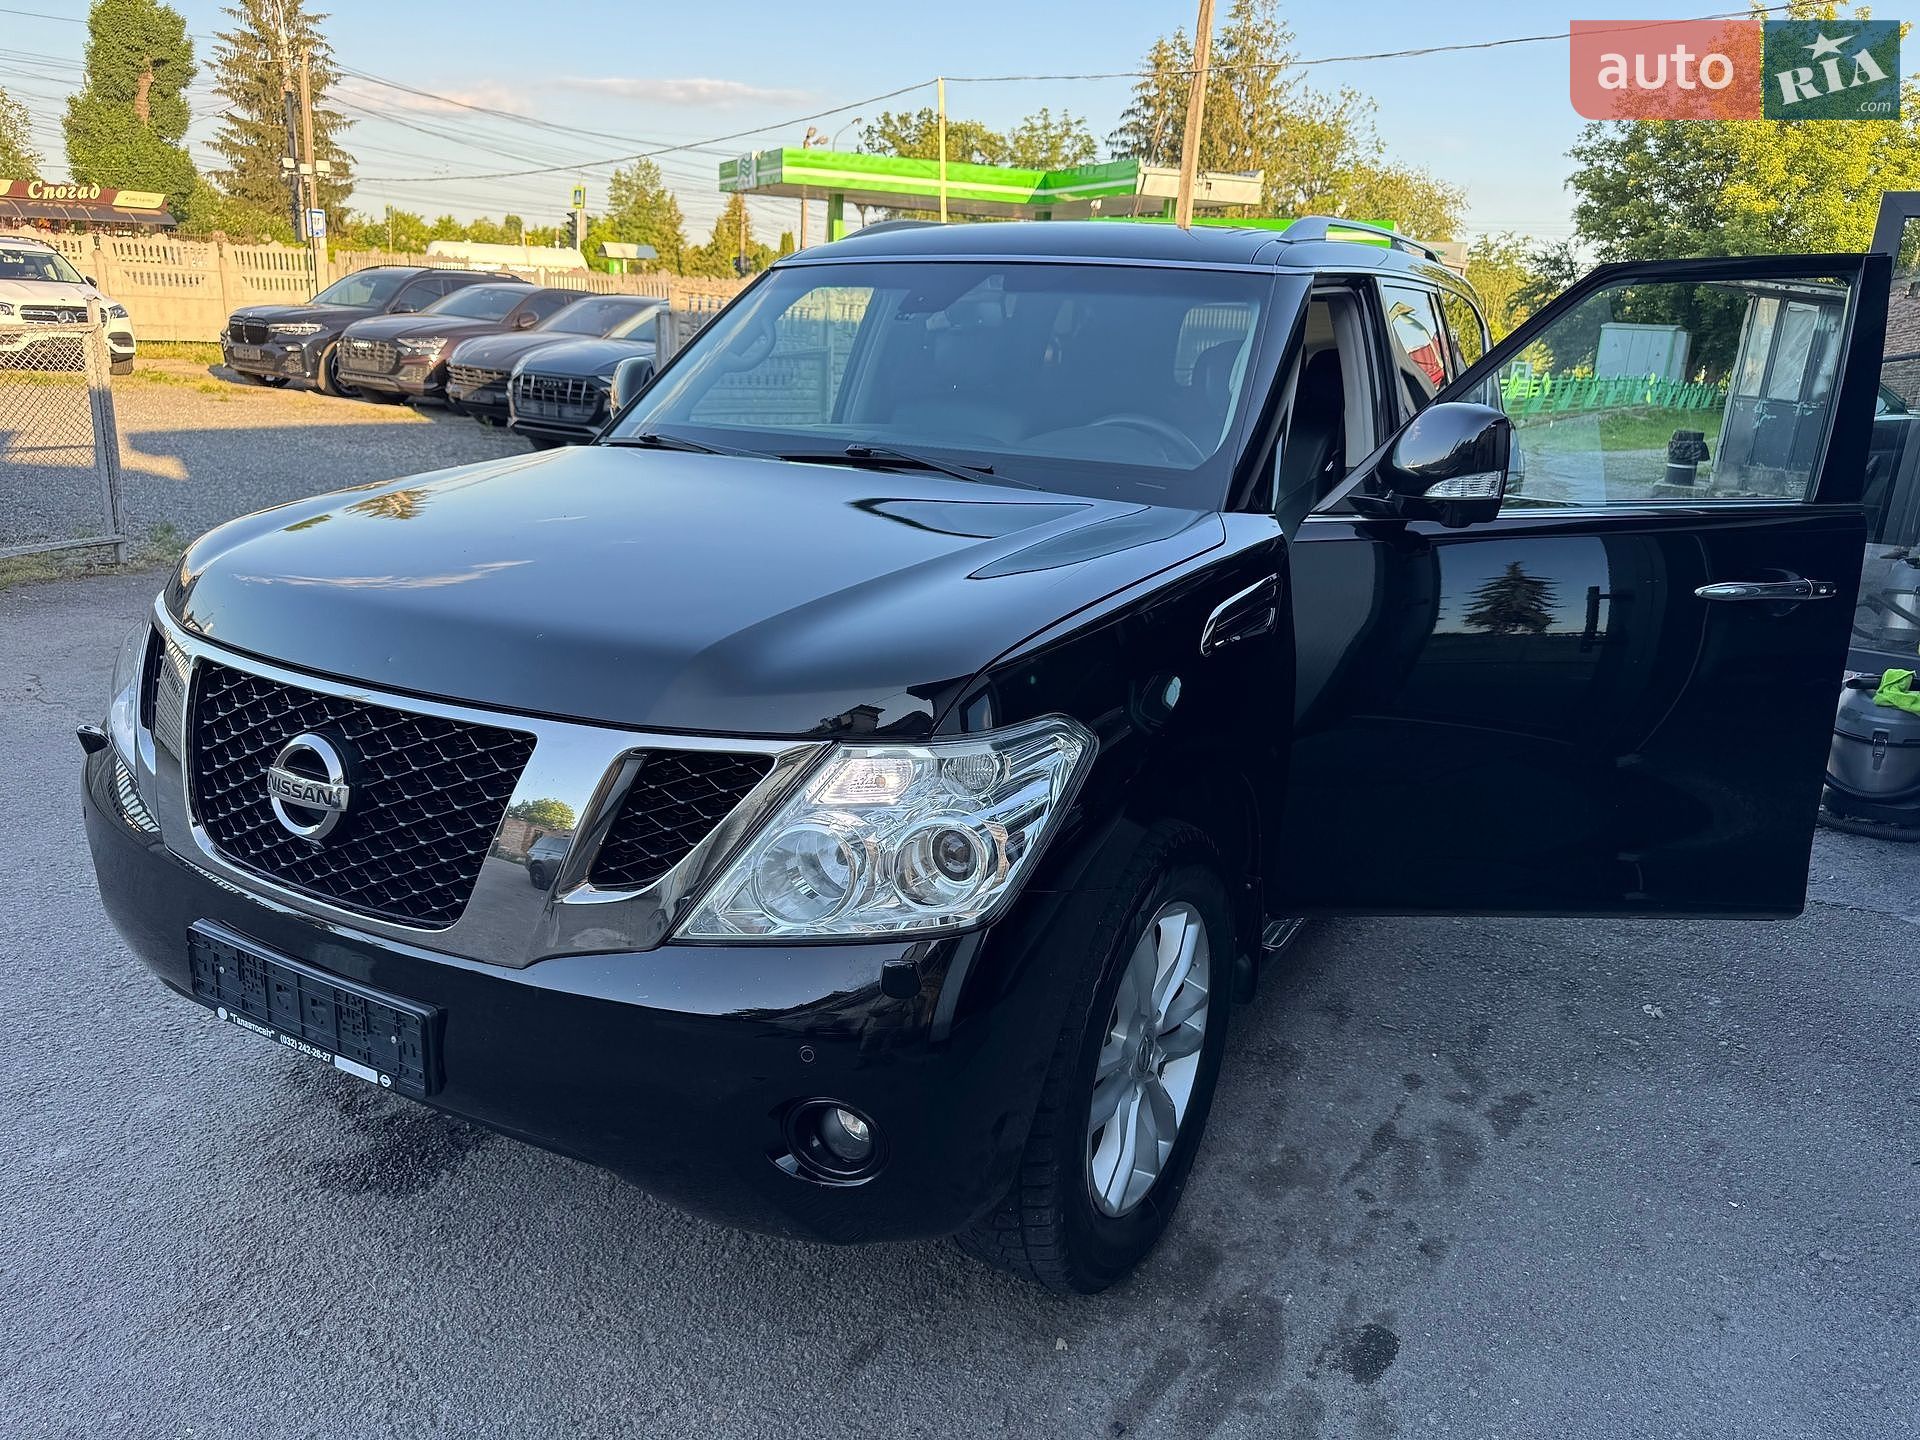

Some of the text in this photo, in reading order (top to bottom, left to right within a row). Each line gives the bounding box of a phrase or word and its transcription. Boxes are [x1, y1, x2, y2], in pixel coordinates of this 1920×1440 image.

[27, 181, 101, 200] Спогад
[269, 776, 334, 805] NISSAN
[280, 1034, 297, 1049] (032)
